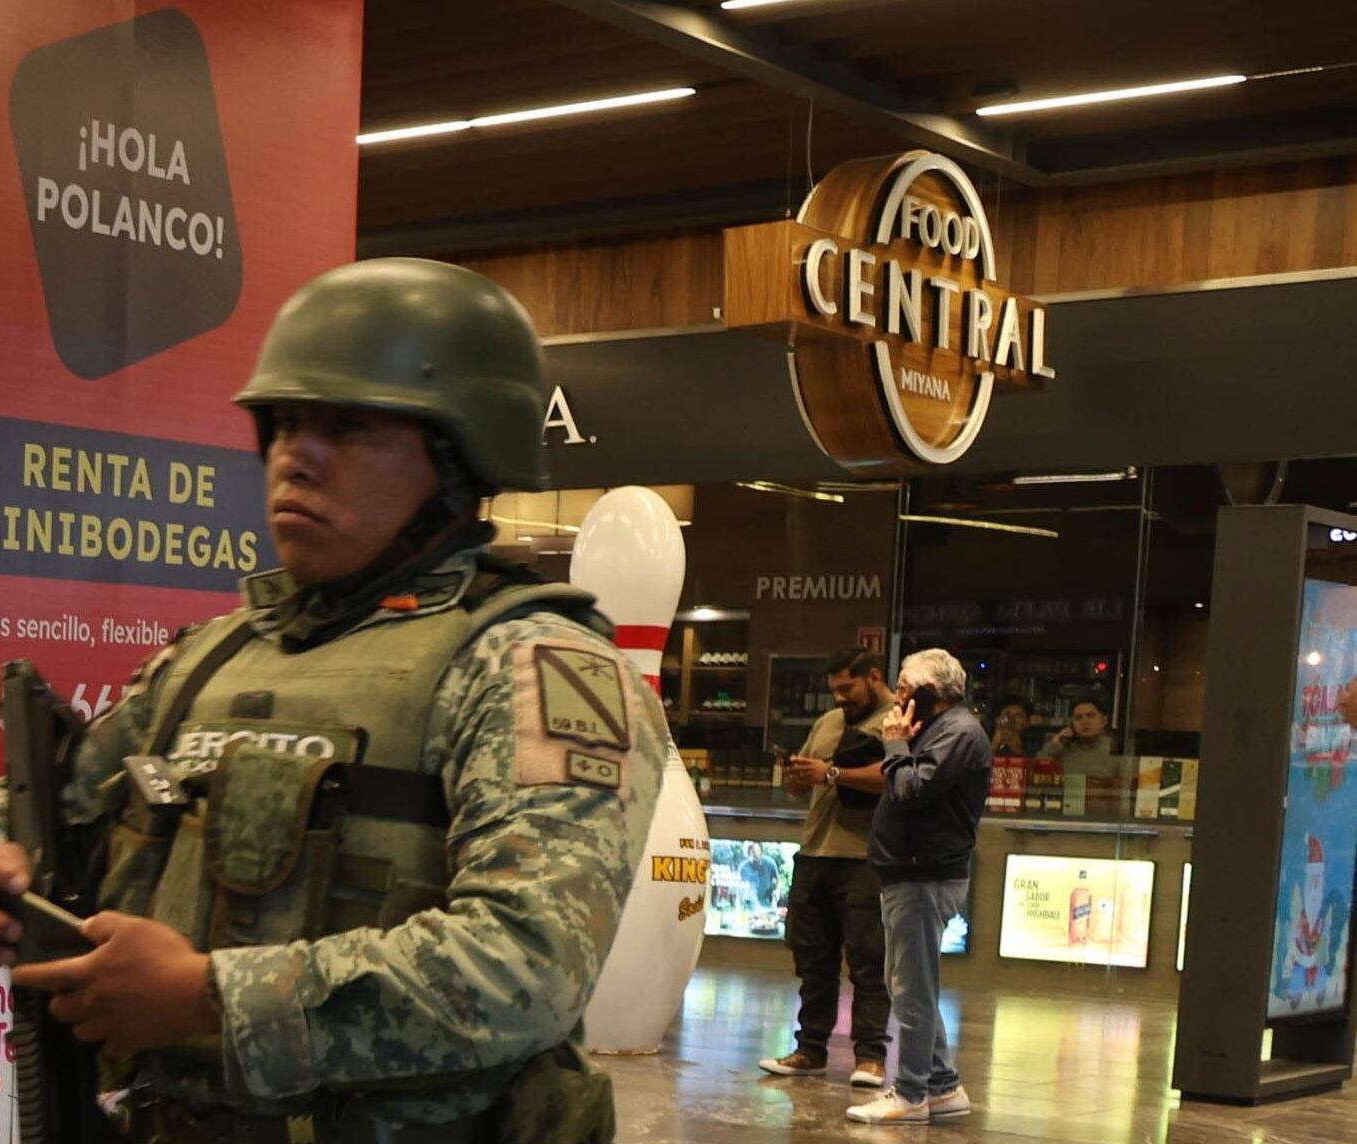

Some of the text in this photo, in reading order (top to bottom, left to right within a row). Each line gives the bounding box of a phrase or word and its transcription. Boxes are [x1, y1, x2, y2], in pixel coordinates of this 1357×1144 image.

[78, 119, 191, 185] ¡HOLA
[37, 176, 225, 260] POLANCO!
[900, 195, 980, 260] FOOD
[804, 238, 1056, 380] CENTRAL
[901, 366, 951, 402] MIYANA
[23, 443, 216, 508] RENTA DE
[756, 575, 882, 600] PREMIUM
[16, 614, 97, 649] sencillo,
[101, 616, 169, 647] flexible
[1014, 877, 1039, 892] GRAN
